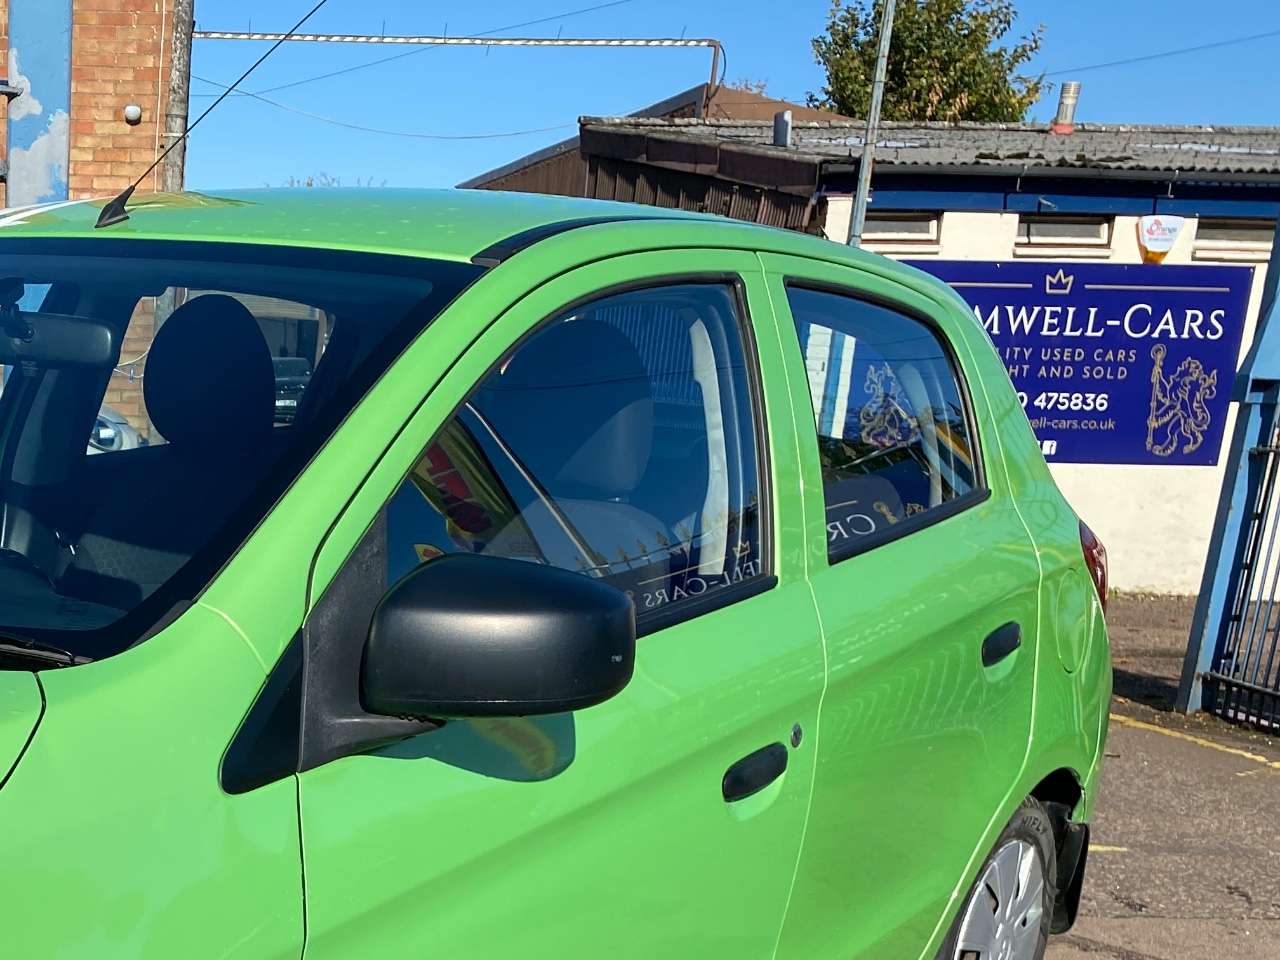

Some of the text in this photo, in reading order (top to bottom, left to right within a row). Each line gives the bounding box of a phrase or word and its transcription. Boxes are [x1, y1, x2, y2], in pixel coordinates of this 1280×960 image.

[973, 303, 1225, 341] MWELL-CARS
[1041, 347, 1085, 362] USED
[1093, 348, 1137, 363] CARS
[1037, 365, 1074, 379] AND
[1082, 365, 1128, 380] SOLD
[1033, 391, 1109, 412] 475836
[1029, 416, 1116, 431] ell-cars.co.uk
